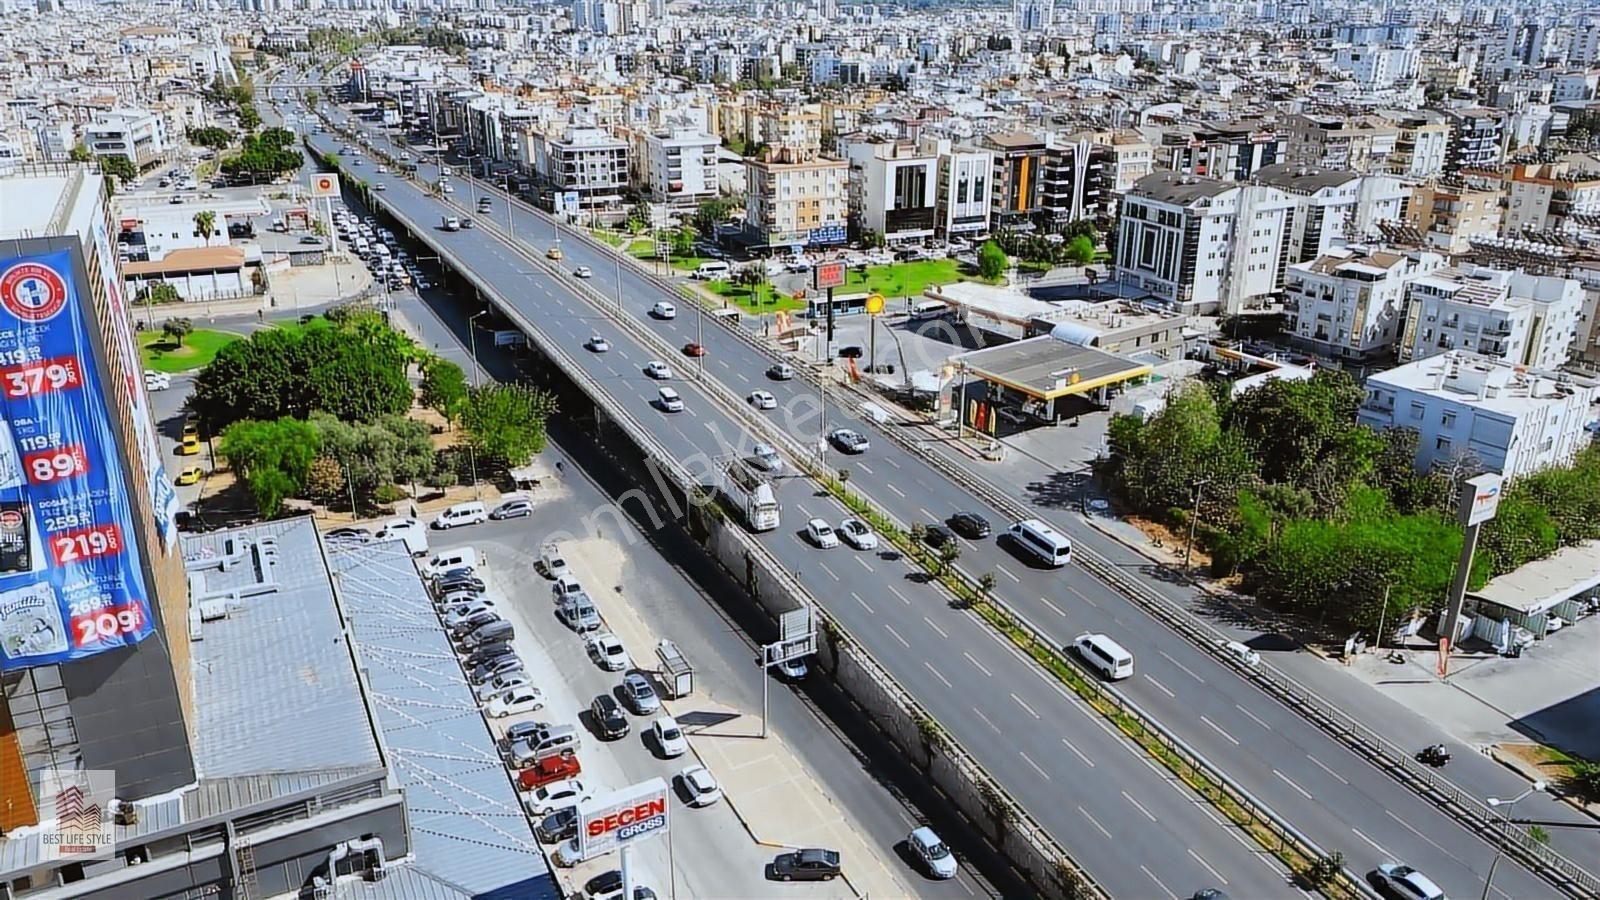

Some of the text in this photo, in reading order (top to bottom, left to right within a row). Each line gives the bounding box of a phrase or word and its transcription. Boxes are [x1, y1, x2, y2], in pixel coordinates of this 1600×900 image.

[6, 364, 67, 396] 379
[32, 453, 75, 480] 89
[56, 531, 107, 562] 219
[78, 610, 136, 644] 209
[620, 816, 663, 838] GROSS
